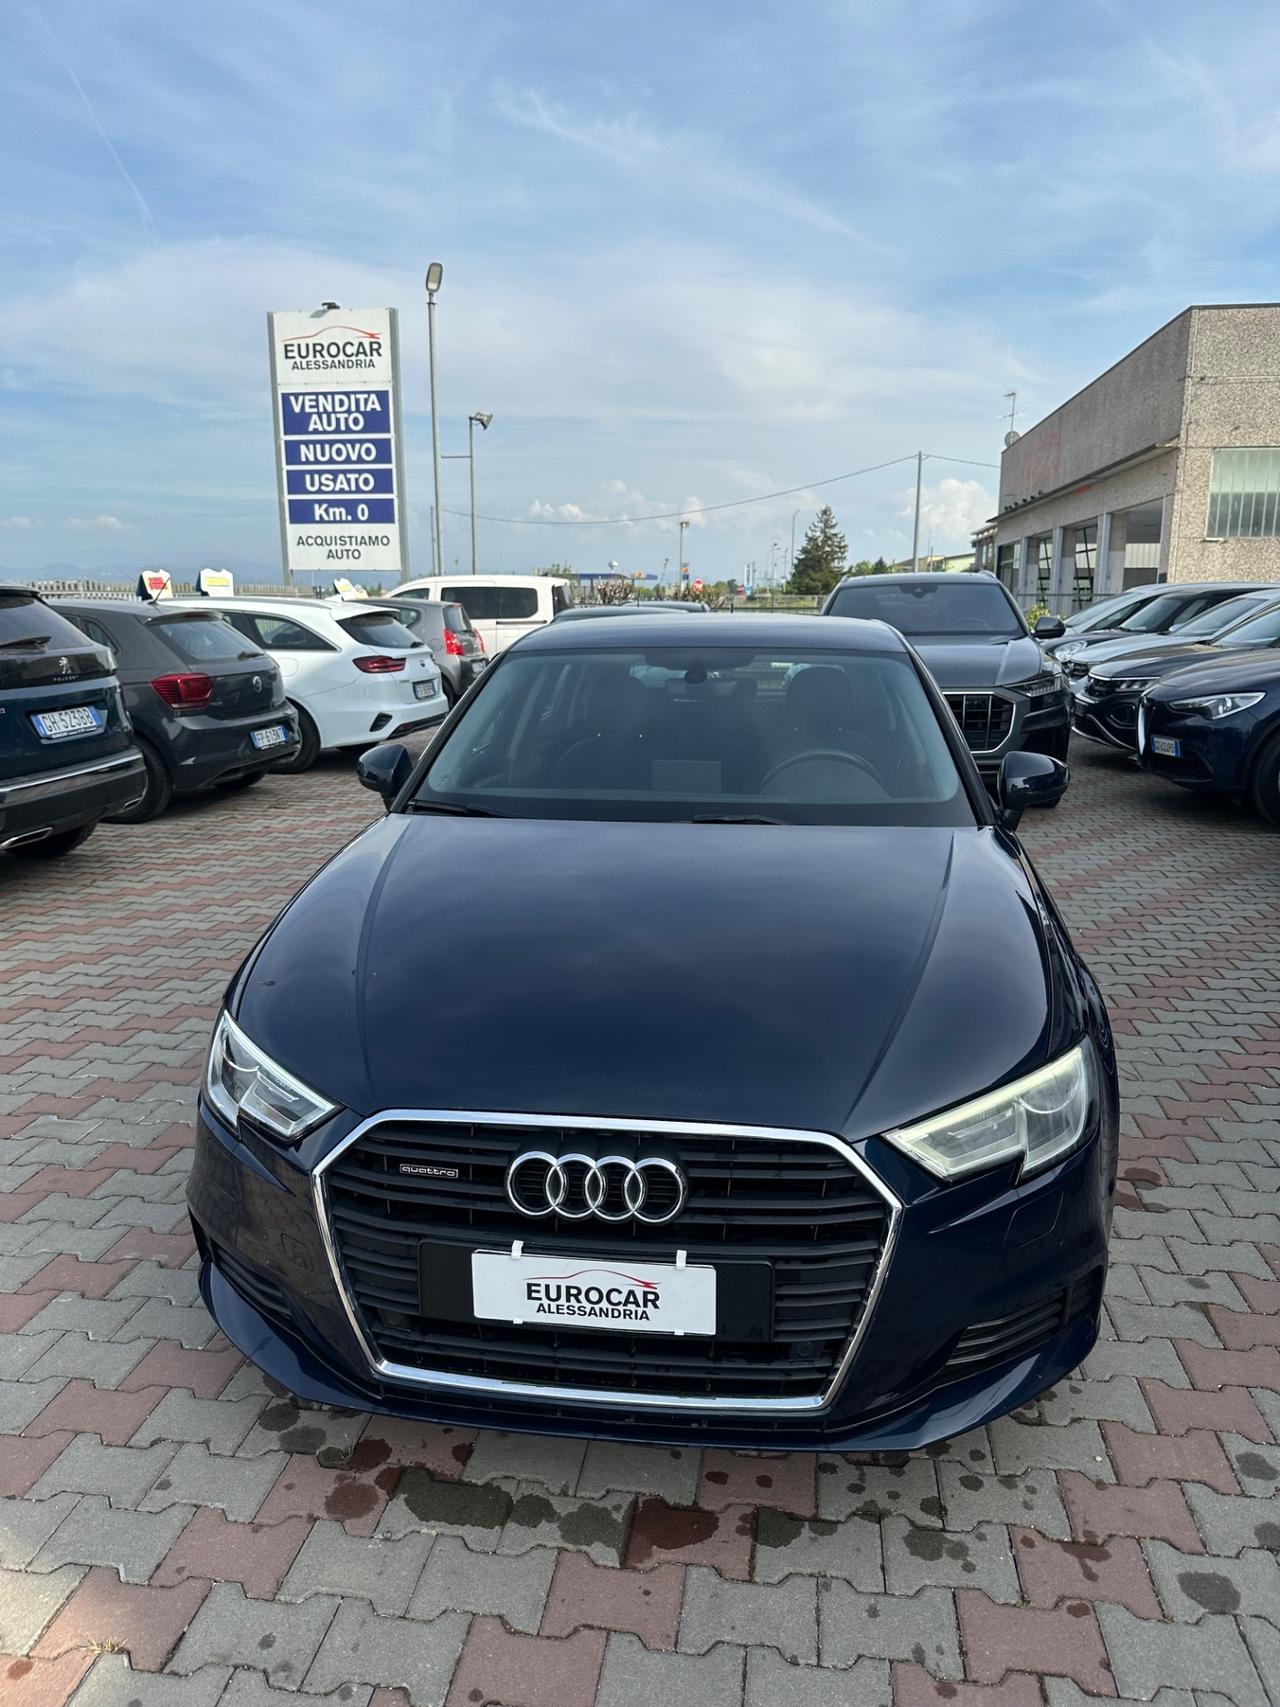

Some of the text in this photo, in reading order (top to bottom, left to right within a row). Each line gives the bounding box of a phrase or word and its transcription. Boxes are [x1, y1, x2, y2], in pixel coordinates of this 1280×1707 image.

[284, 341, 382, 360] EUROCAR
[291, 359, 376, 371] ALESSANDRIA
[289, 393, 382, 413] VENDITA
[307, 413, 365, 431] AUTO
[299, 443, 377, 462] NUOVO
[304, 473, 375, 492] USATO
[313, 504, 369, 521] Km. 0
[296, 535, 390, 548] ACQUISTIAMO
[326, 549, 362, 560] AUTO
[401, 1166, 456, 1177] quattro
[526, 1282, 661, 1310] EUROCAR
[536, 1302, 651, 1321] ALESSANDRIA
